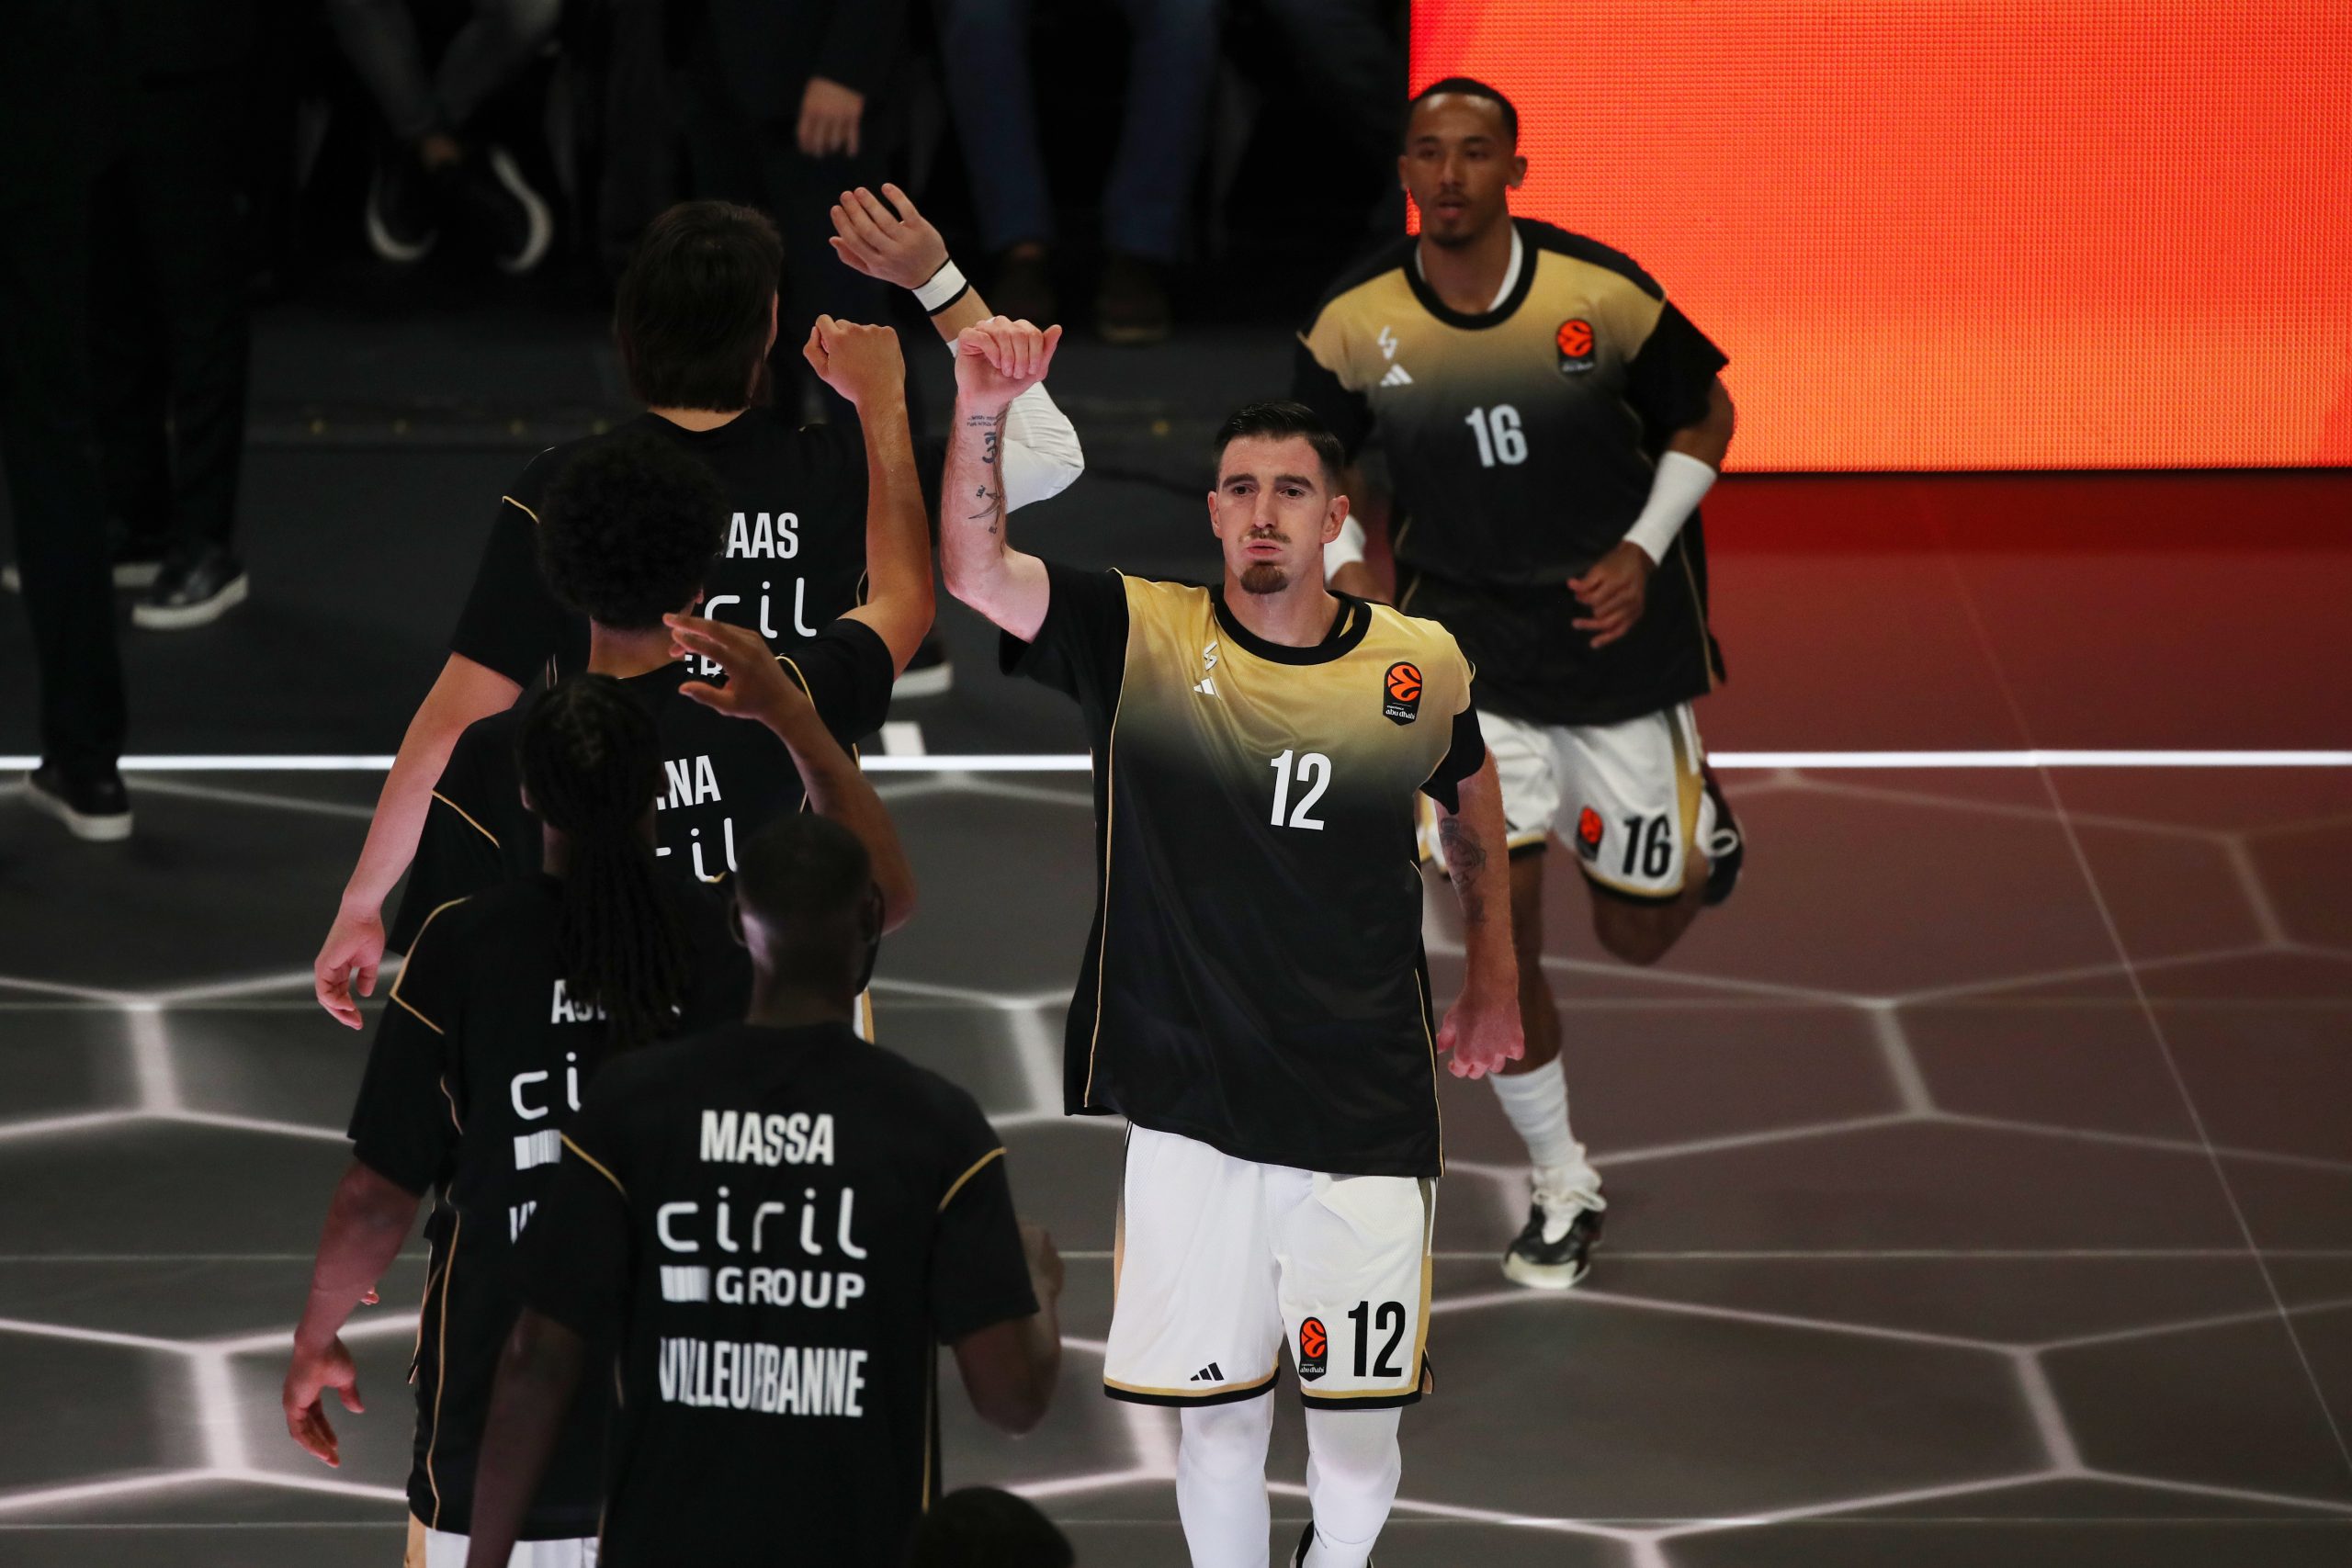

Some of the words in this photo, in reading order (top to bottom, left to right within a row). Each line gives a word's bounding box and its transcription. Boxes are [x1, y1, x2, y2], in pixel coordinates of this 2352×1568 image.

[1465, 404, 1528, 468] 16
[656, 754, 722, 811] NA
[1270, 749, 1332, 831] 12
[1623, 814, 1672, 878] 16
[700, 1110, 835, 1167] MASSA
[656, 1185, 868, 1260] ciril
[715, 1266, 866, 1310] GROUP
[1348, 1301, 1407, 1378] 12
